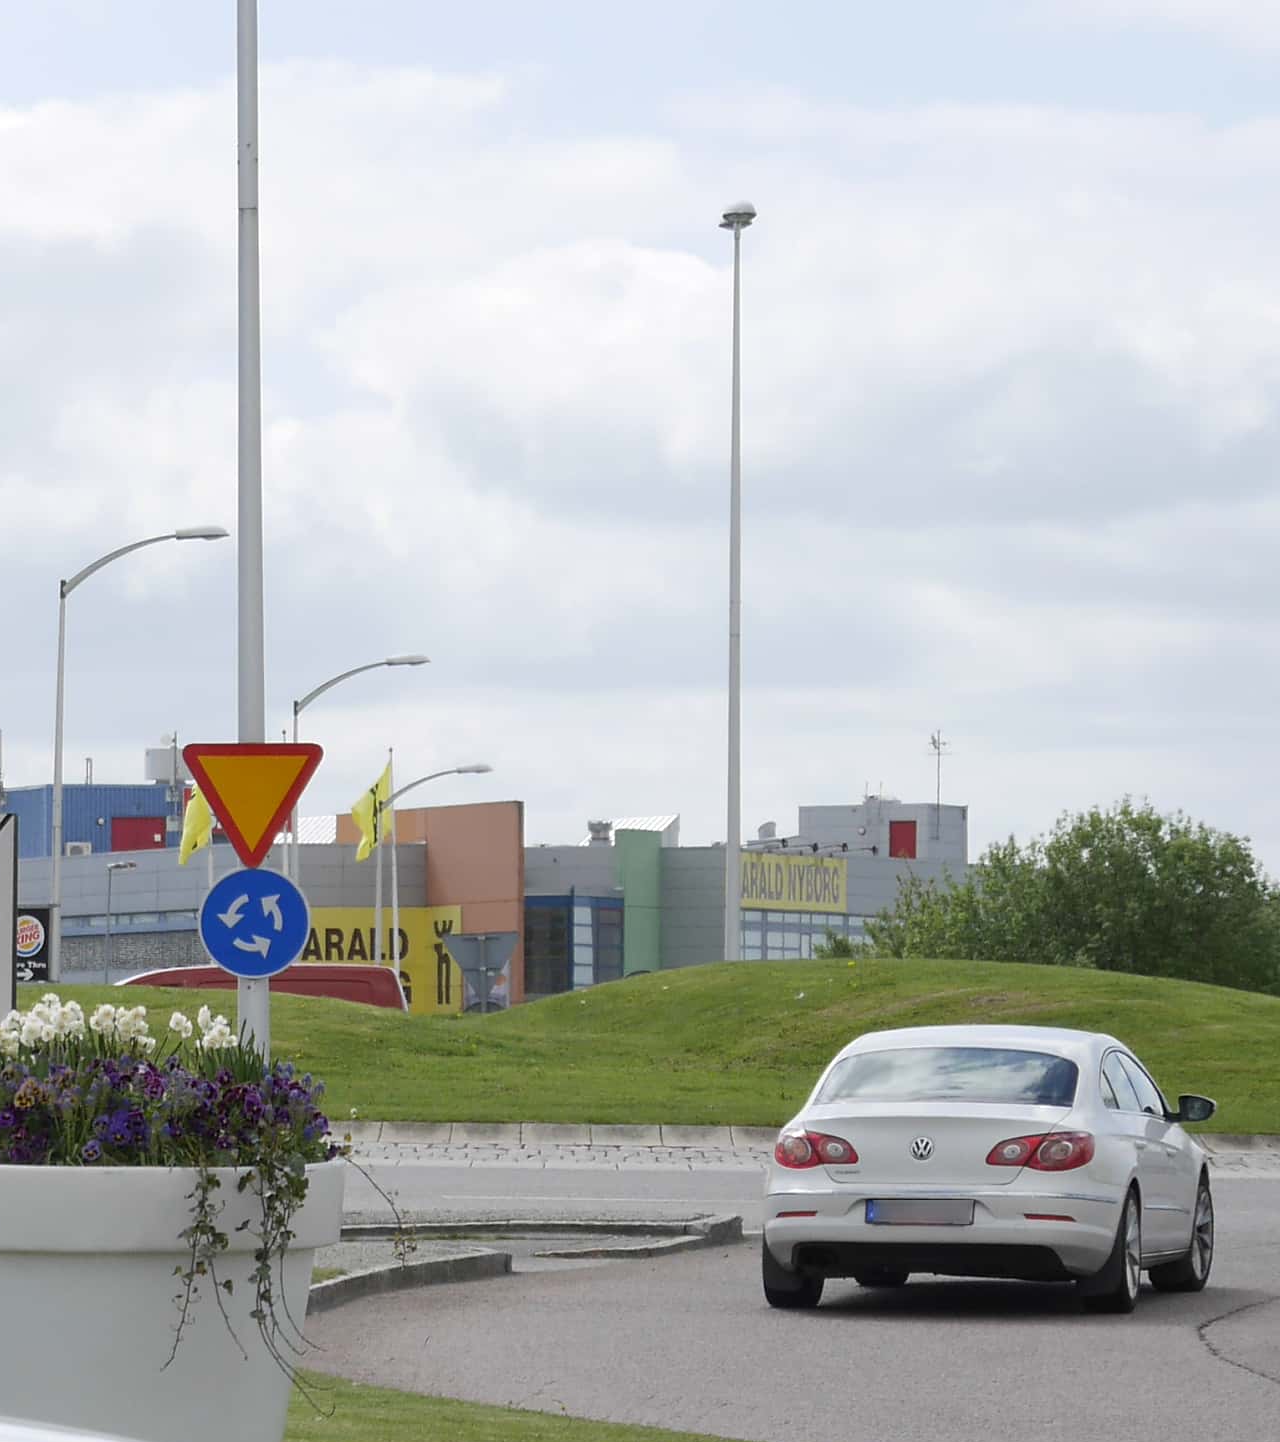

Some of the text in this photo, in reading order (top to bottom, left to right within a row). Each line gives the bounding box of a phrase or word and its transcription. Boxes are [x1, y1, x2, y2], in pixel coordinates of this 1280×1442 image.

[741, 861, 839, 904] ARALD NYBORG
[301, 927, 409, 961] ARALD
